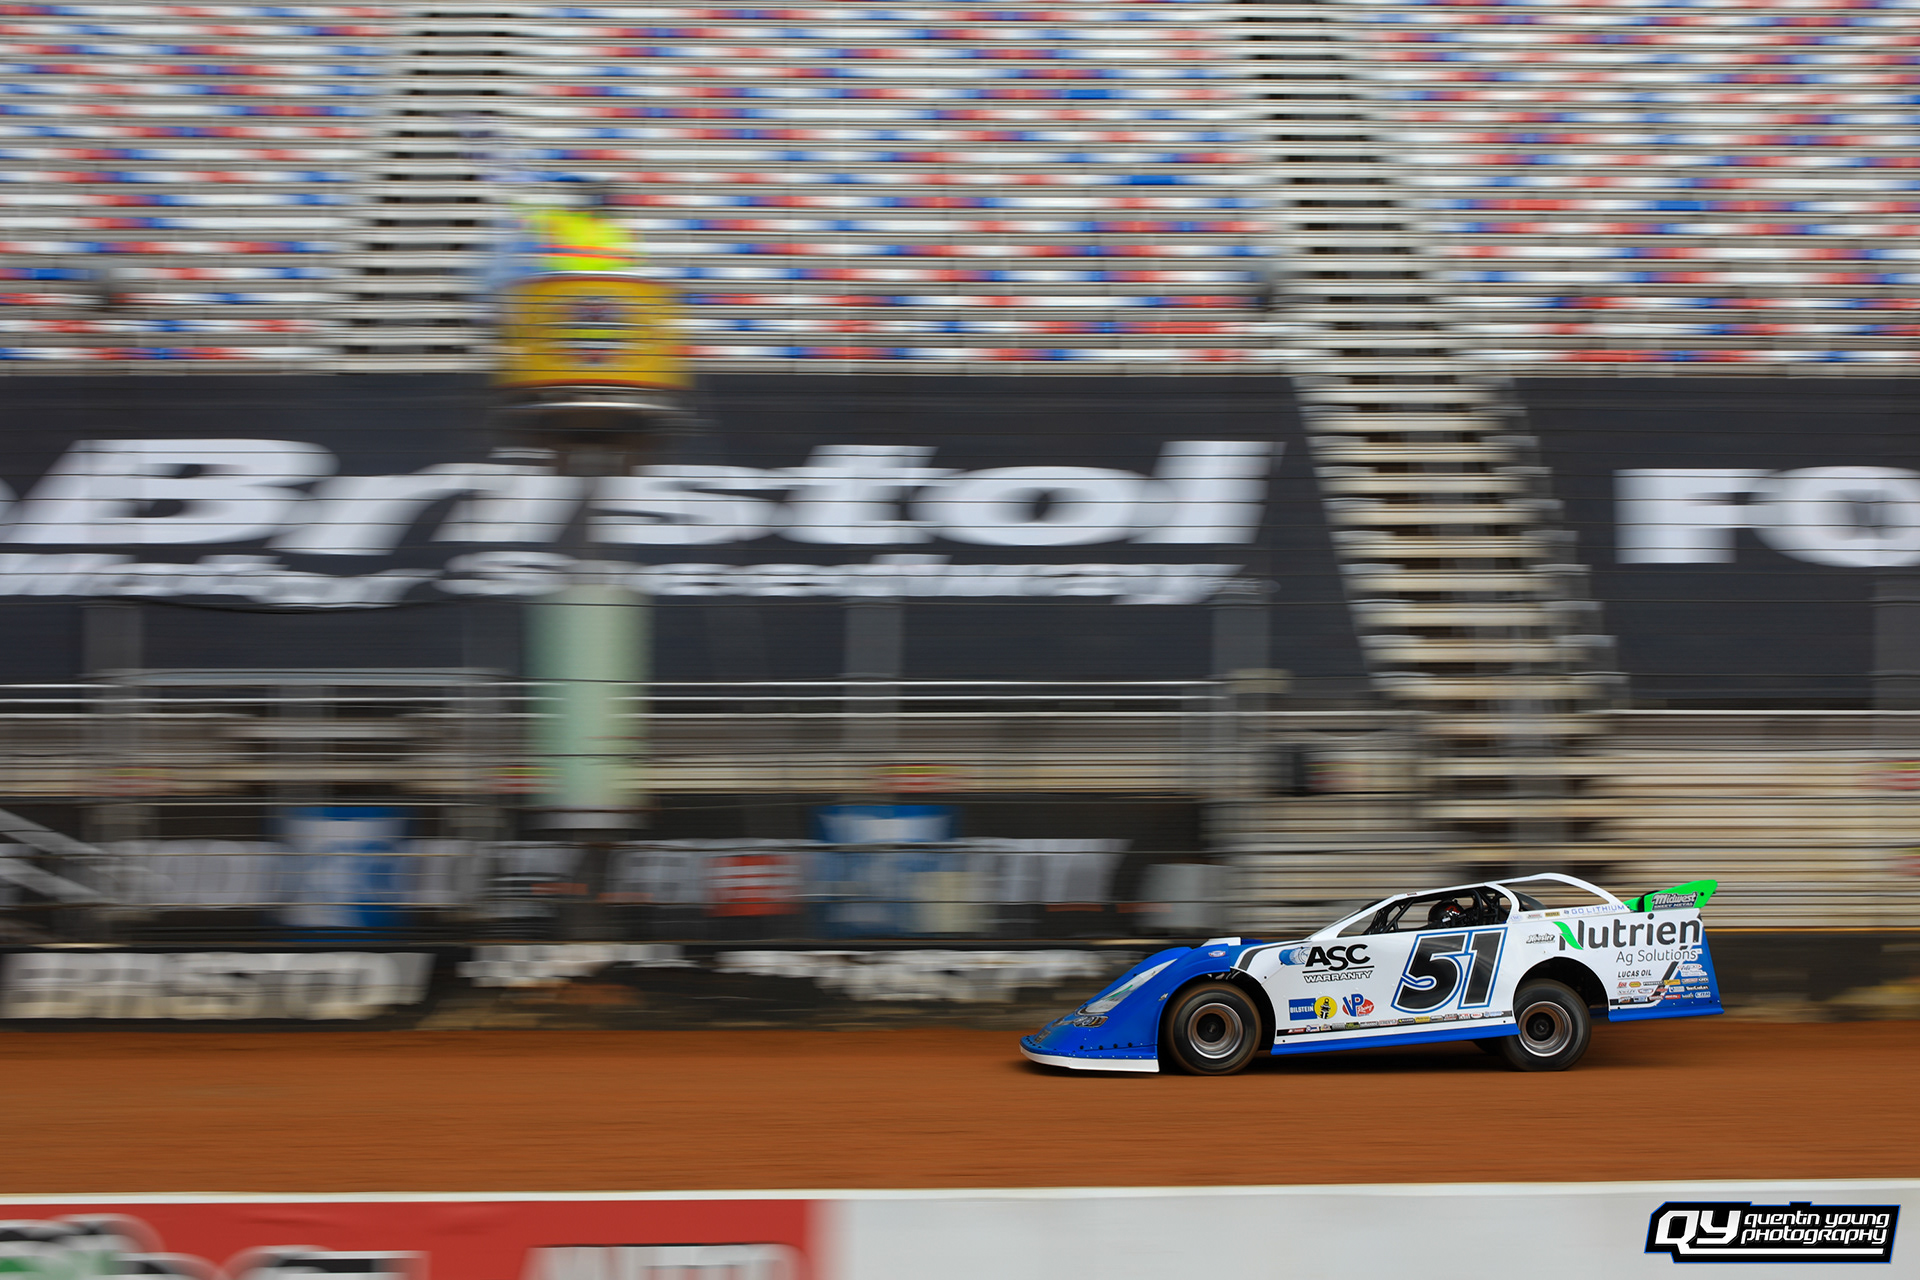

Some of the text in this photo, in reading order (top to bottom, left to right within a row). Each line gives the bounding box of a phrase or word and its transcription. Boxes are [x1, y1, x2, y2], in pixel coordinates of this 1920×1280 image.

[5, 438, 1280, 554] Bristol
[1652, 892, 1697, 904] Midwest
[1586, 905, 1625, 914] LITHIUM
[1553, 912, 1701, 951] Nutrien
[1305, 944, 1371, 971] ASC
[1616, 948, 1697, 966] Ag Solutions
[1303, 970, 1373, 983] WARRANTY
[1391, 927, 1508, 1014] 51
[1617, 970, 1640, 978] LUCAS
[1290, 1004, 1314, 1013] BILSTEIN
[1342, 993, 1364, 1017] VP
